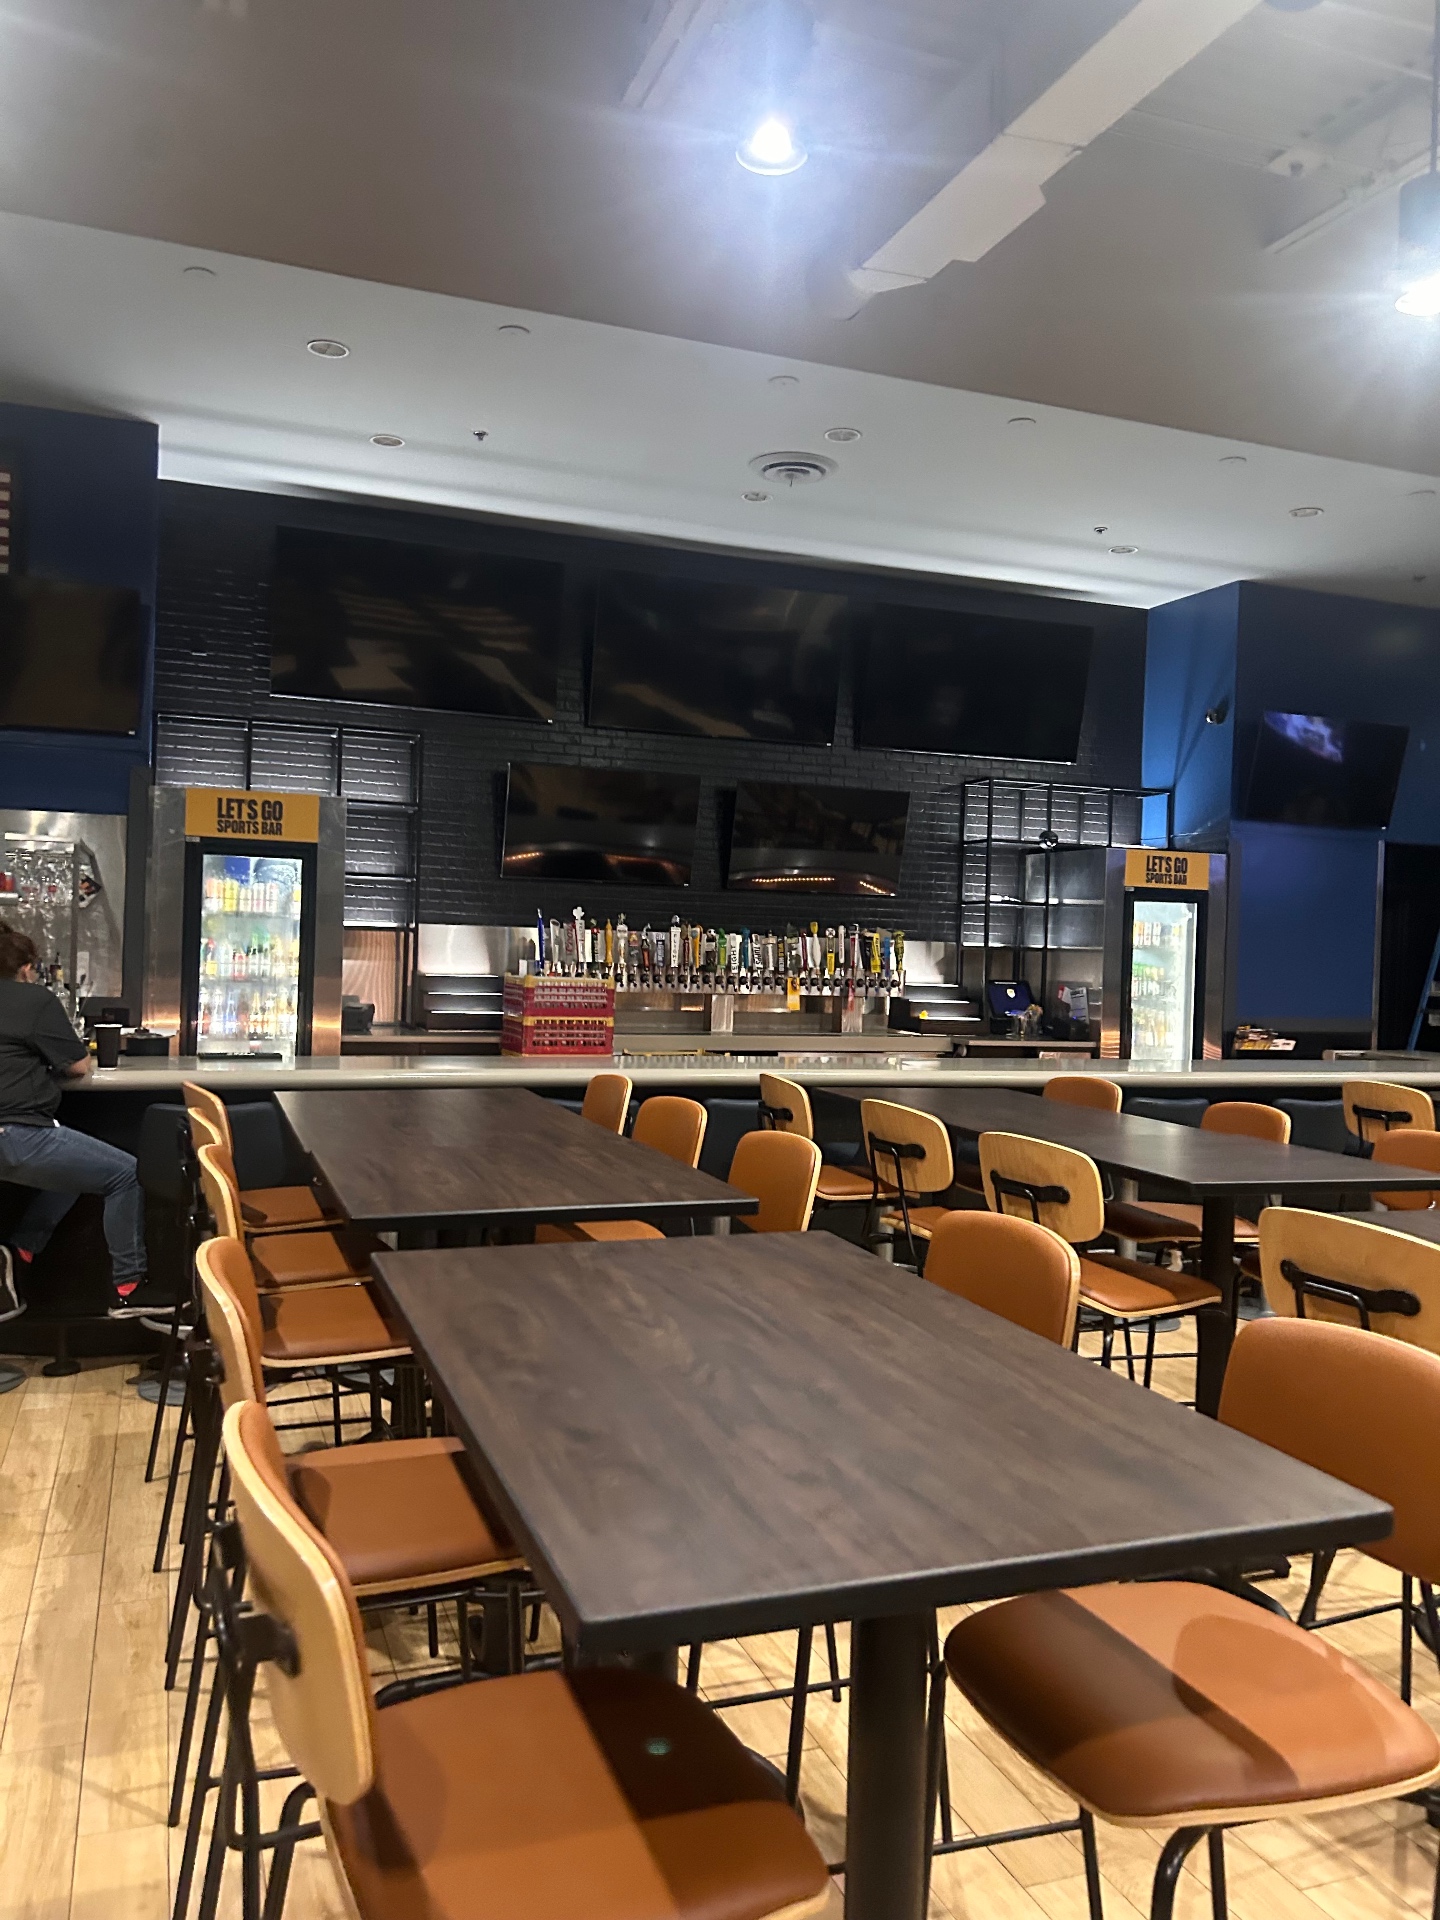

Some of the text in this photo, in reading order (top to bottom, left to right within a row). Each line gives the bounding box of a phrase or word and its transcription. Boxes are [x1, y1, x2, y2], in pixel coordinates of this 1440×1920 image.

[217, 797, 284, 821] LET'S GO
[217, 819, 283, 836] SPORTS BAR
[1146, 855, 1188, 874] LET'S GO
[1145, 872, 1187, 885] SPORTS BAR
